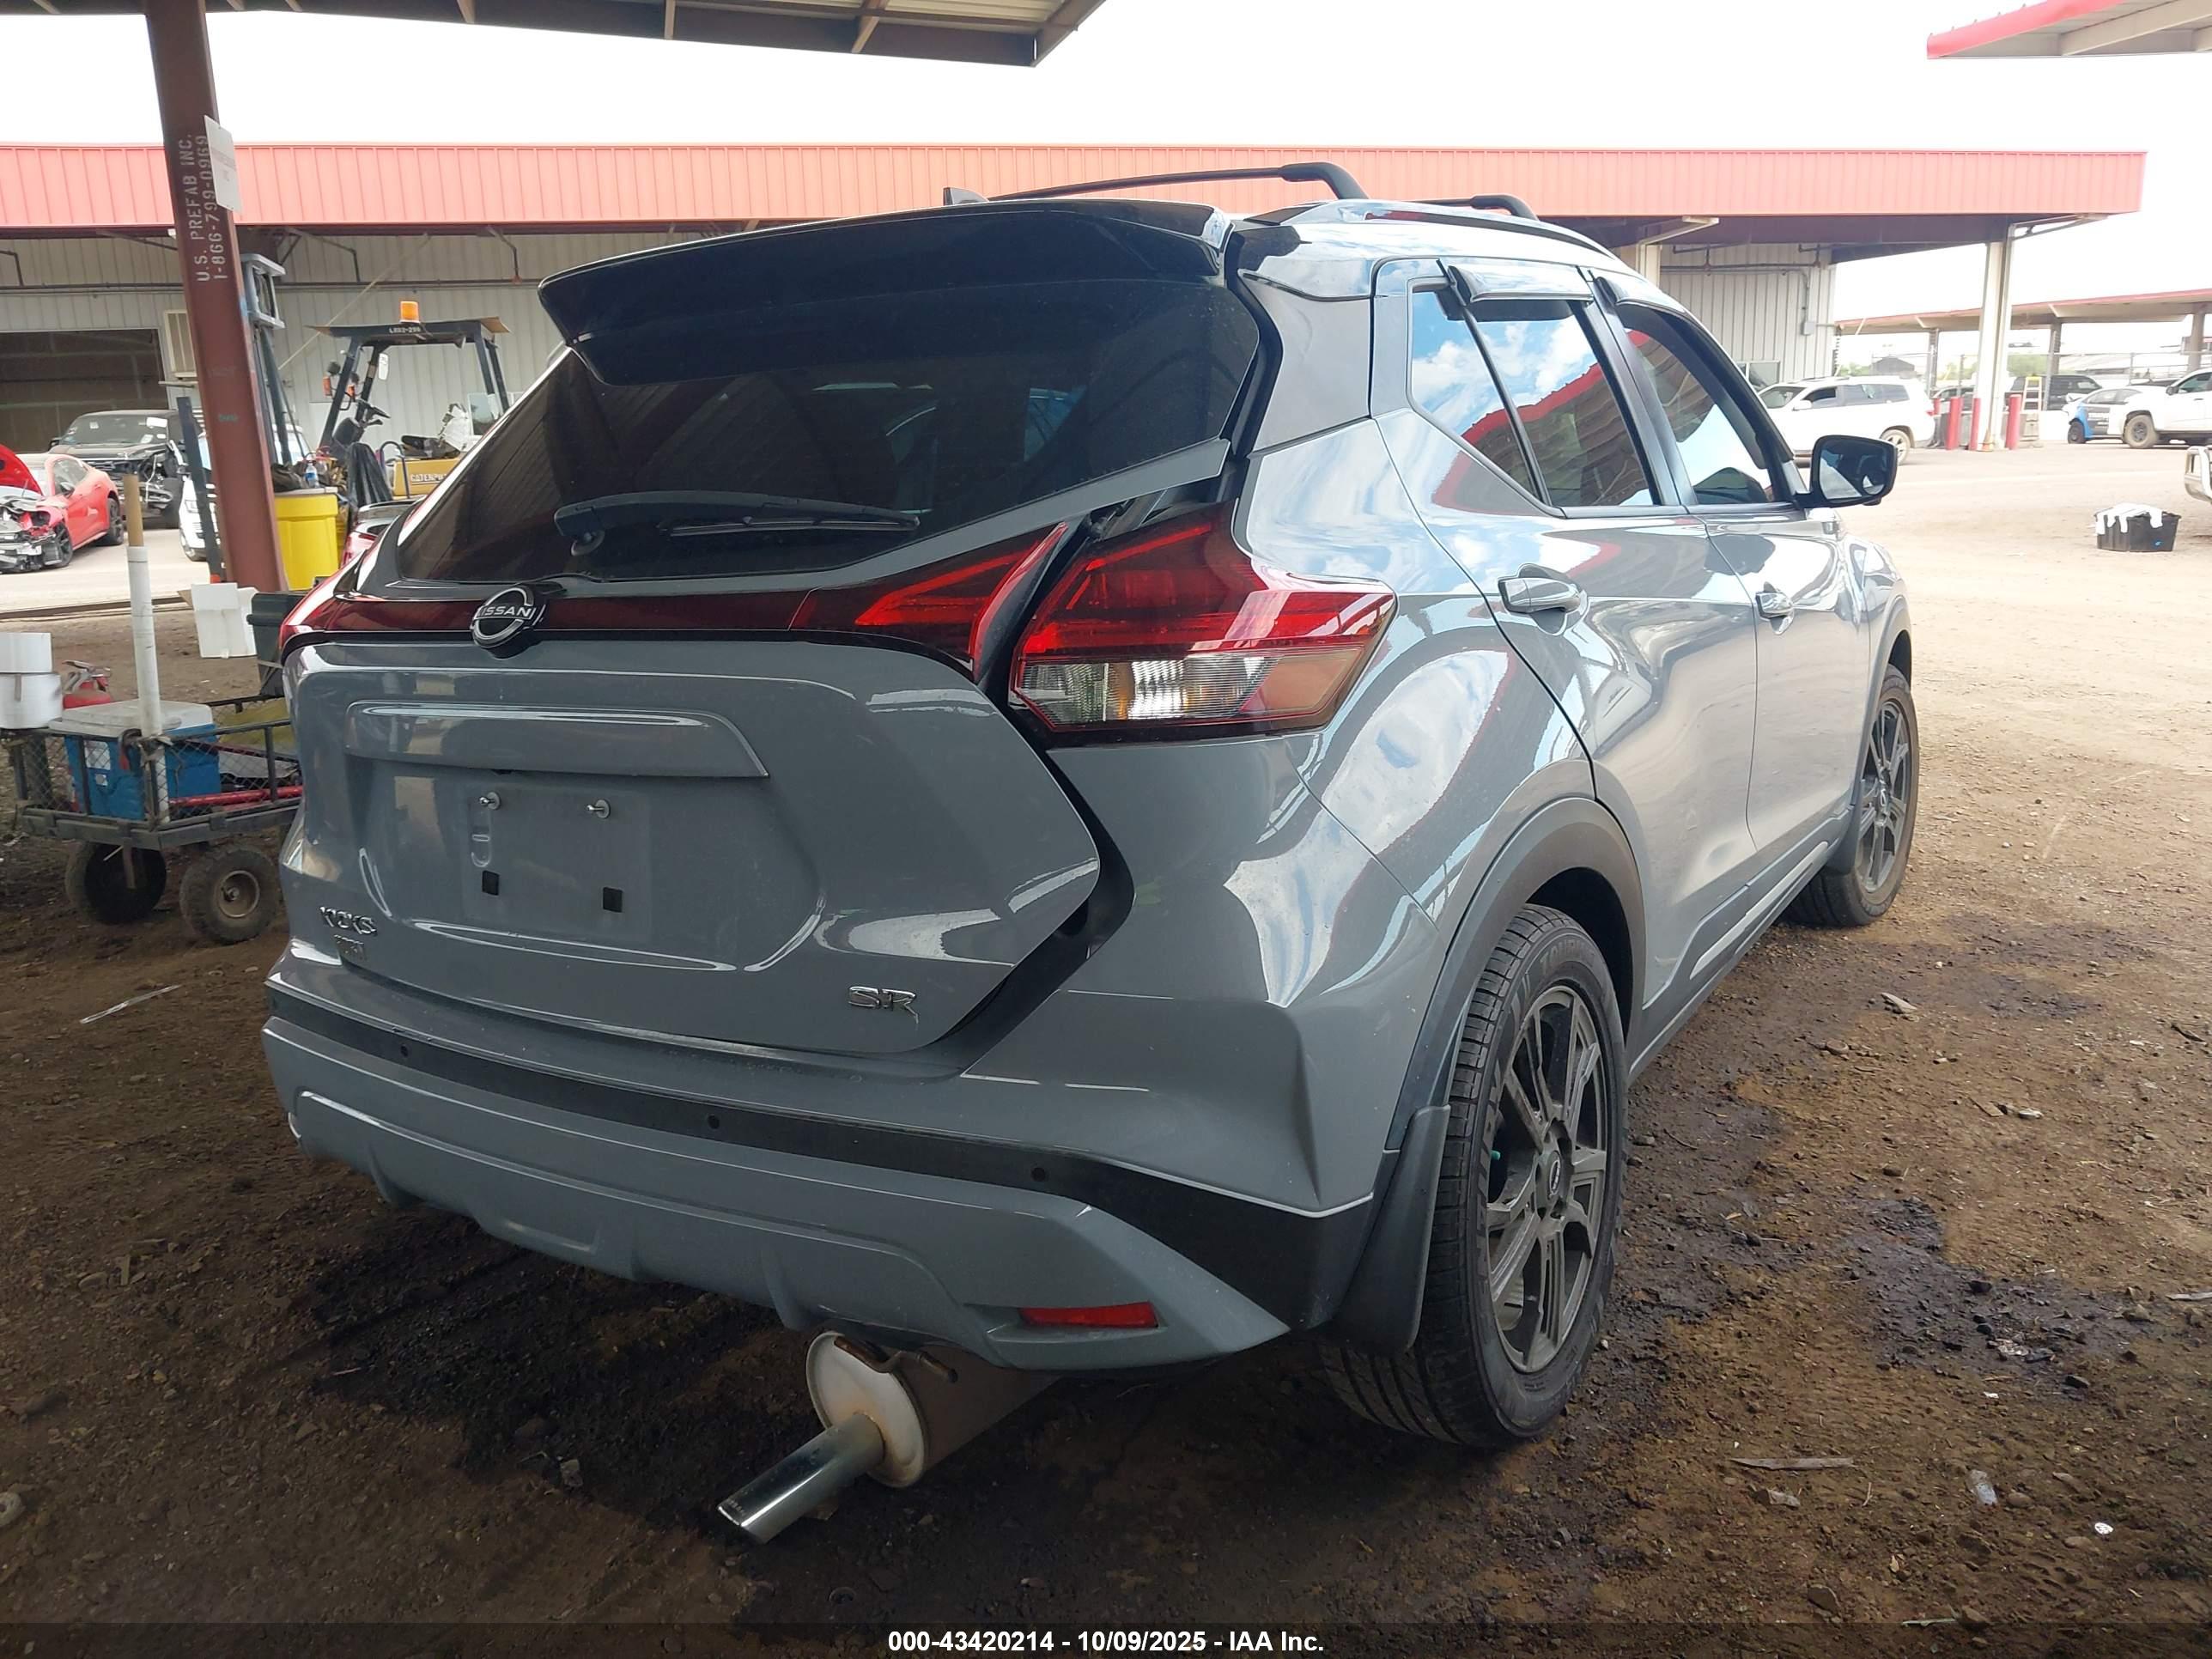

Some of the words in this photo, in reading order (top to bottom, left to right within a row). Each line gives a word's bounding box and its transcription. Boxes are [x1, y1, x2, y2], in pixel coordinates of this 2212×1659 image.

[179, 134, 196, 166] INC.
[182, 174, 205, 240] PREFAB
[193, 250, 211, 282] U.S.
[848, 986, 919, 1024] SR
